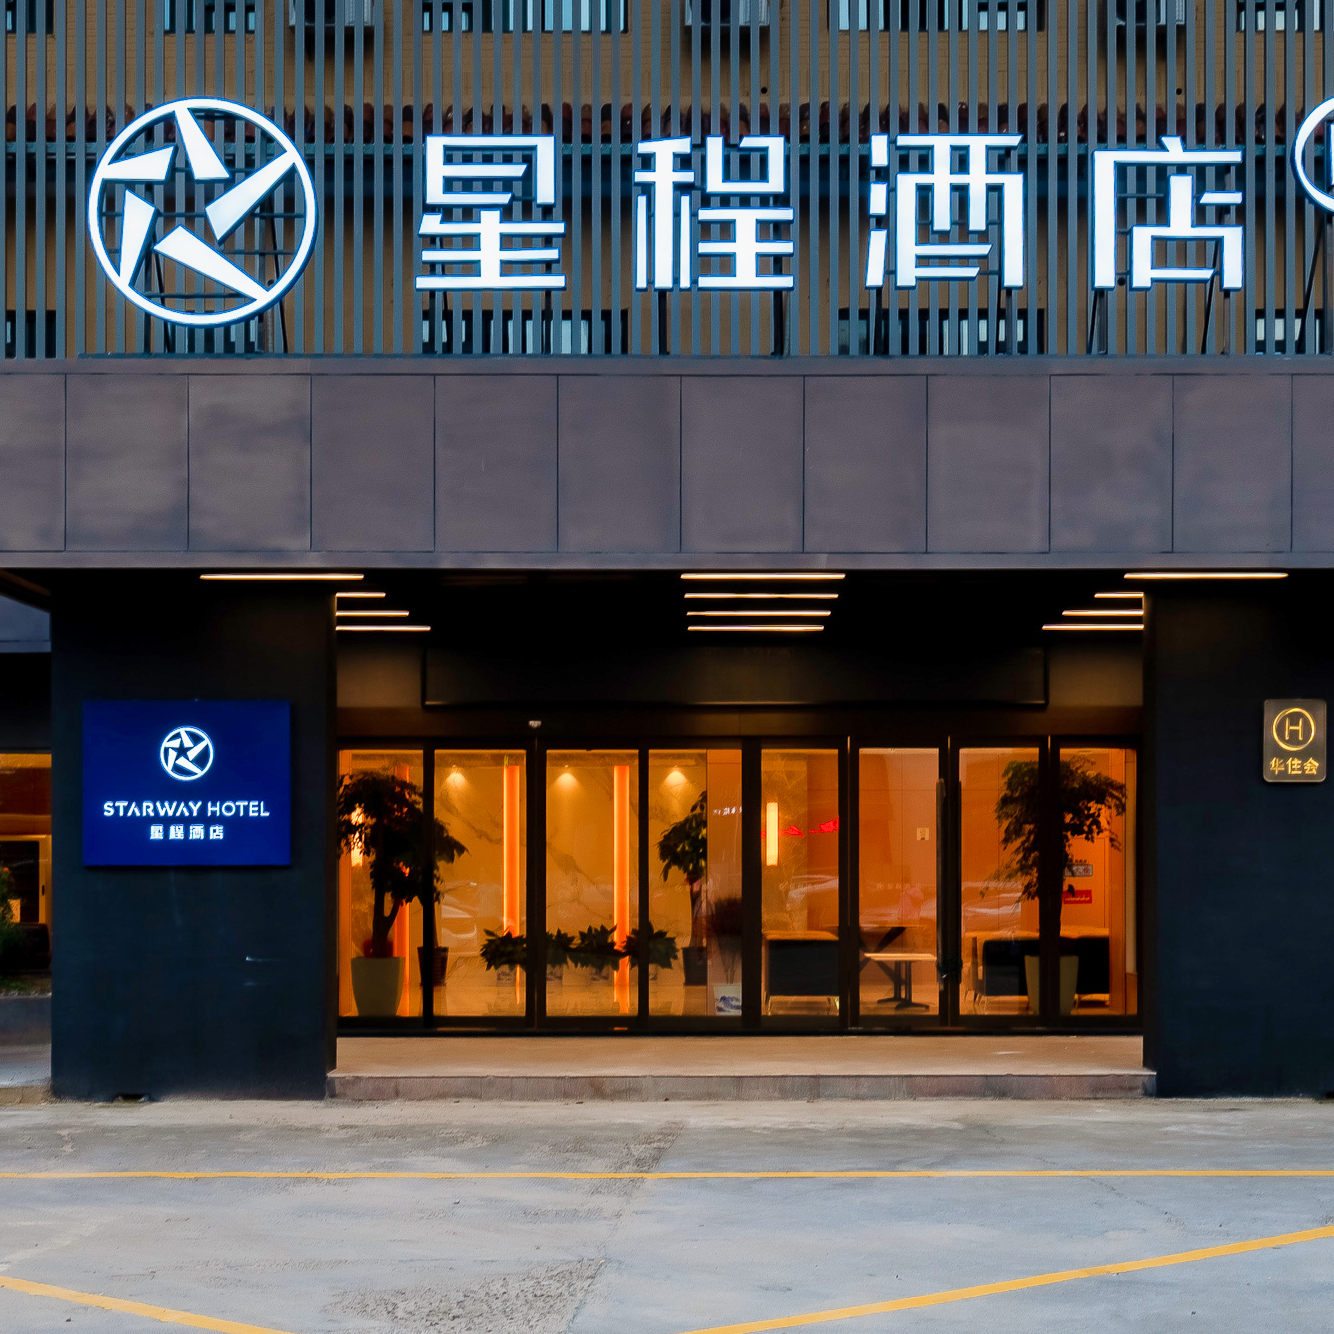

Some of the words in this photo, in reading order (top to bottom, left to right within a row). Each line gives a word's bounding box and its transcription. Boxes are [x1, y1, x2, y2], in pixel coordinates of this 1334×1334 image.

[415, 133, 1244, 291] 星程酒店
[1284, 717, 1304, 741] H
[1269, 757, 1320, 775] 华住会
[103, 800, 203, 817] STARWAY
[207, 800, 271, 817] HOTEL
[149, 824, 225, 841] 星程酒店
